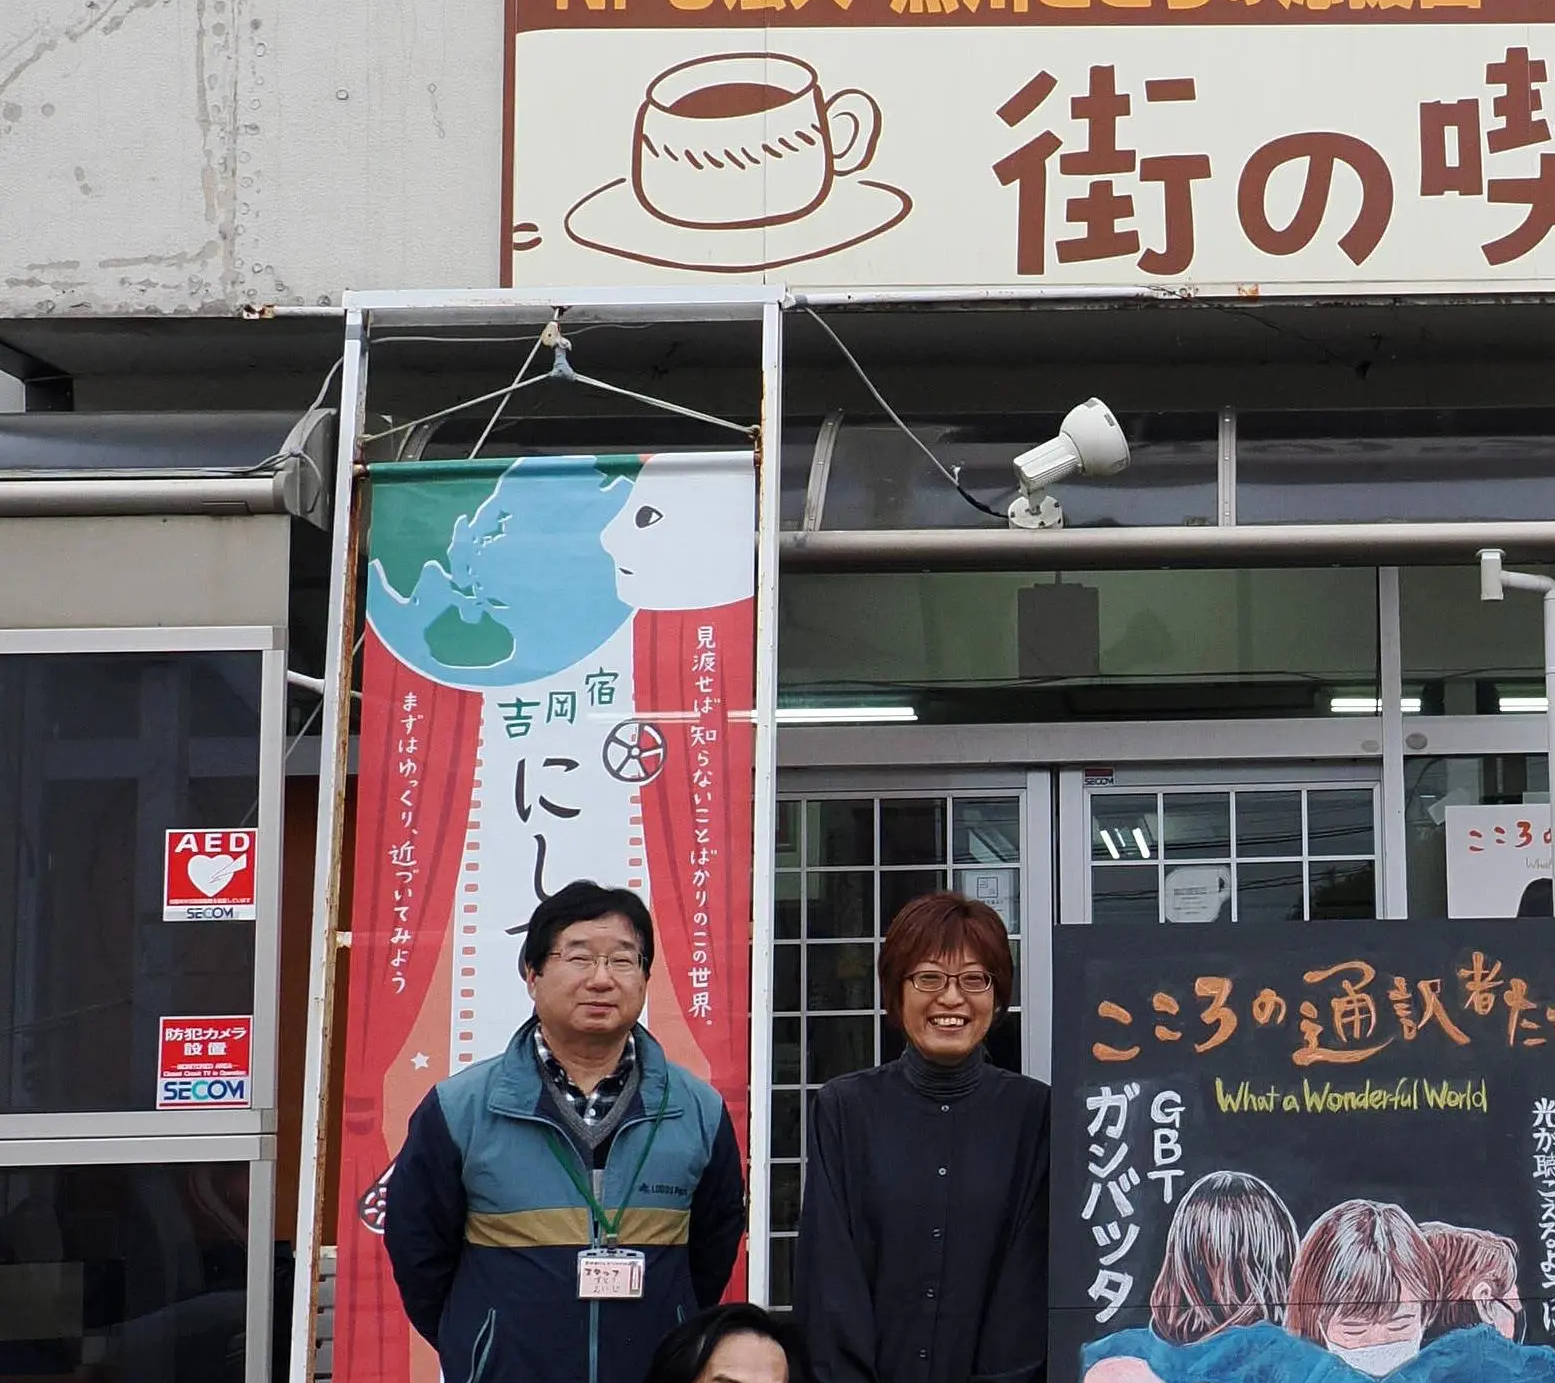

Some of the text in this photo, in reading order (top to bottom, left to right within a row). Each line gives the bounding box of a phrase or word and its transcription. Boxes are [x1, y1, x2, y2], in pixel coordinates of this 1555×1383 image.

[497, 666, 619, 739] 吉岡宿
[174, 832, 250, 853] AED
[186, 907, 234, 919] SECOM
[164, 1026, 247, 1042] 防犯カメラ
[163, 1079, 245, 1101] SECOM
[1215, 1077, 1488, 1114] What a Wonderful World
[1147, 1090, 1186, 1204] GBT
[1082, 1082, 1141, 1324] ガンバッタ
